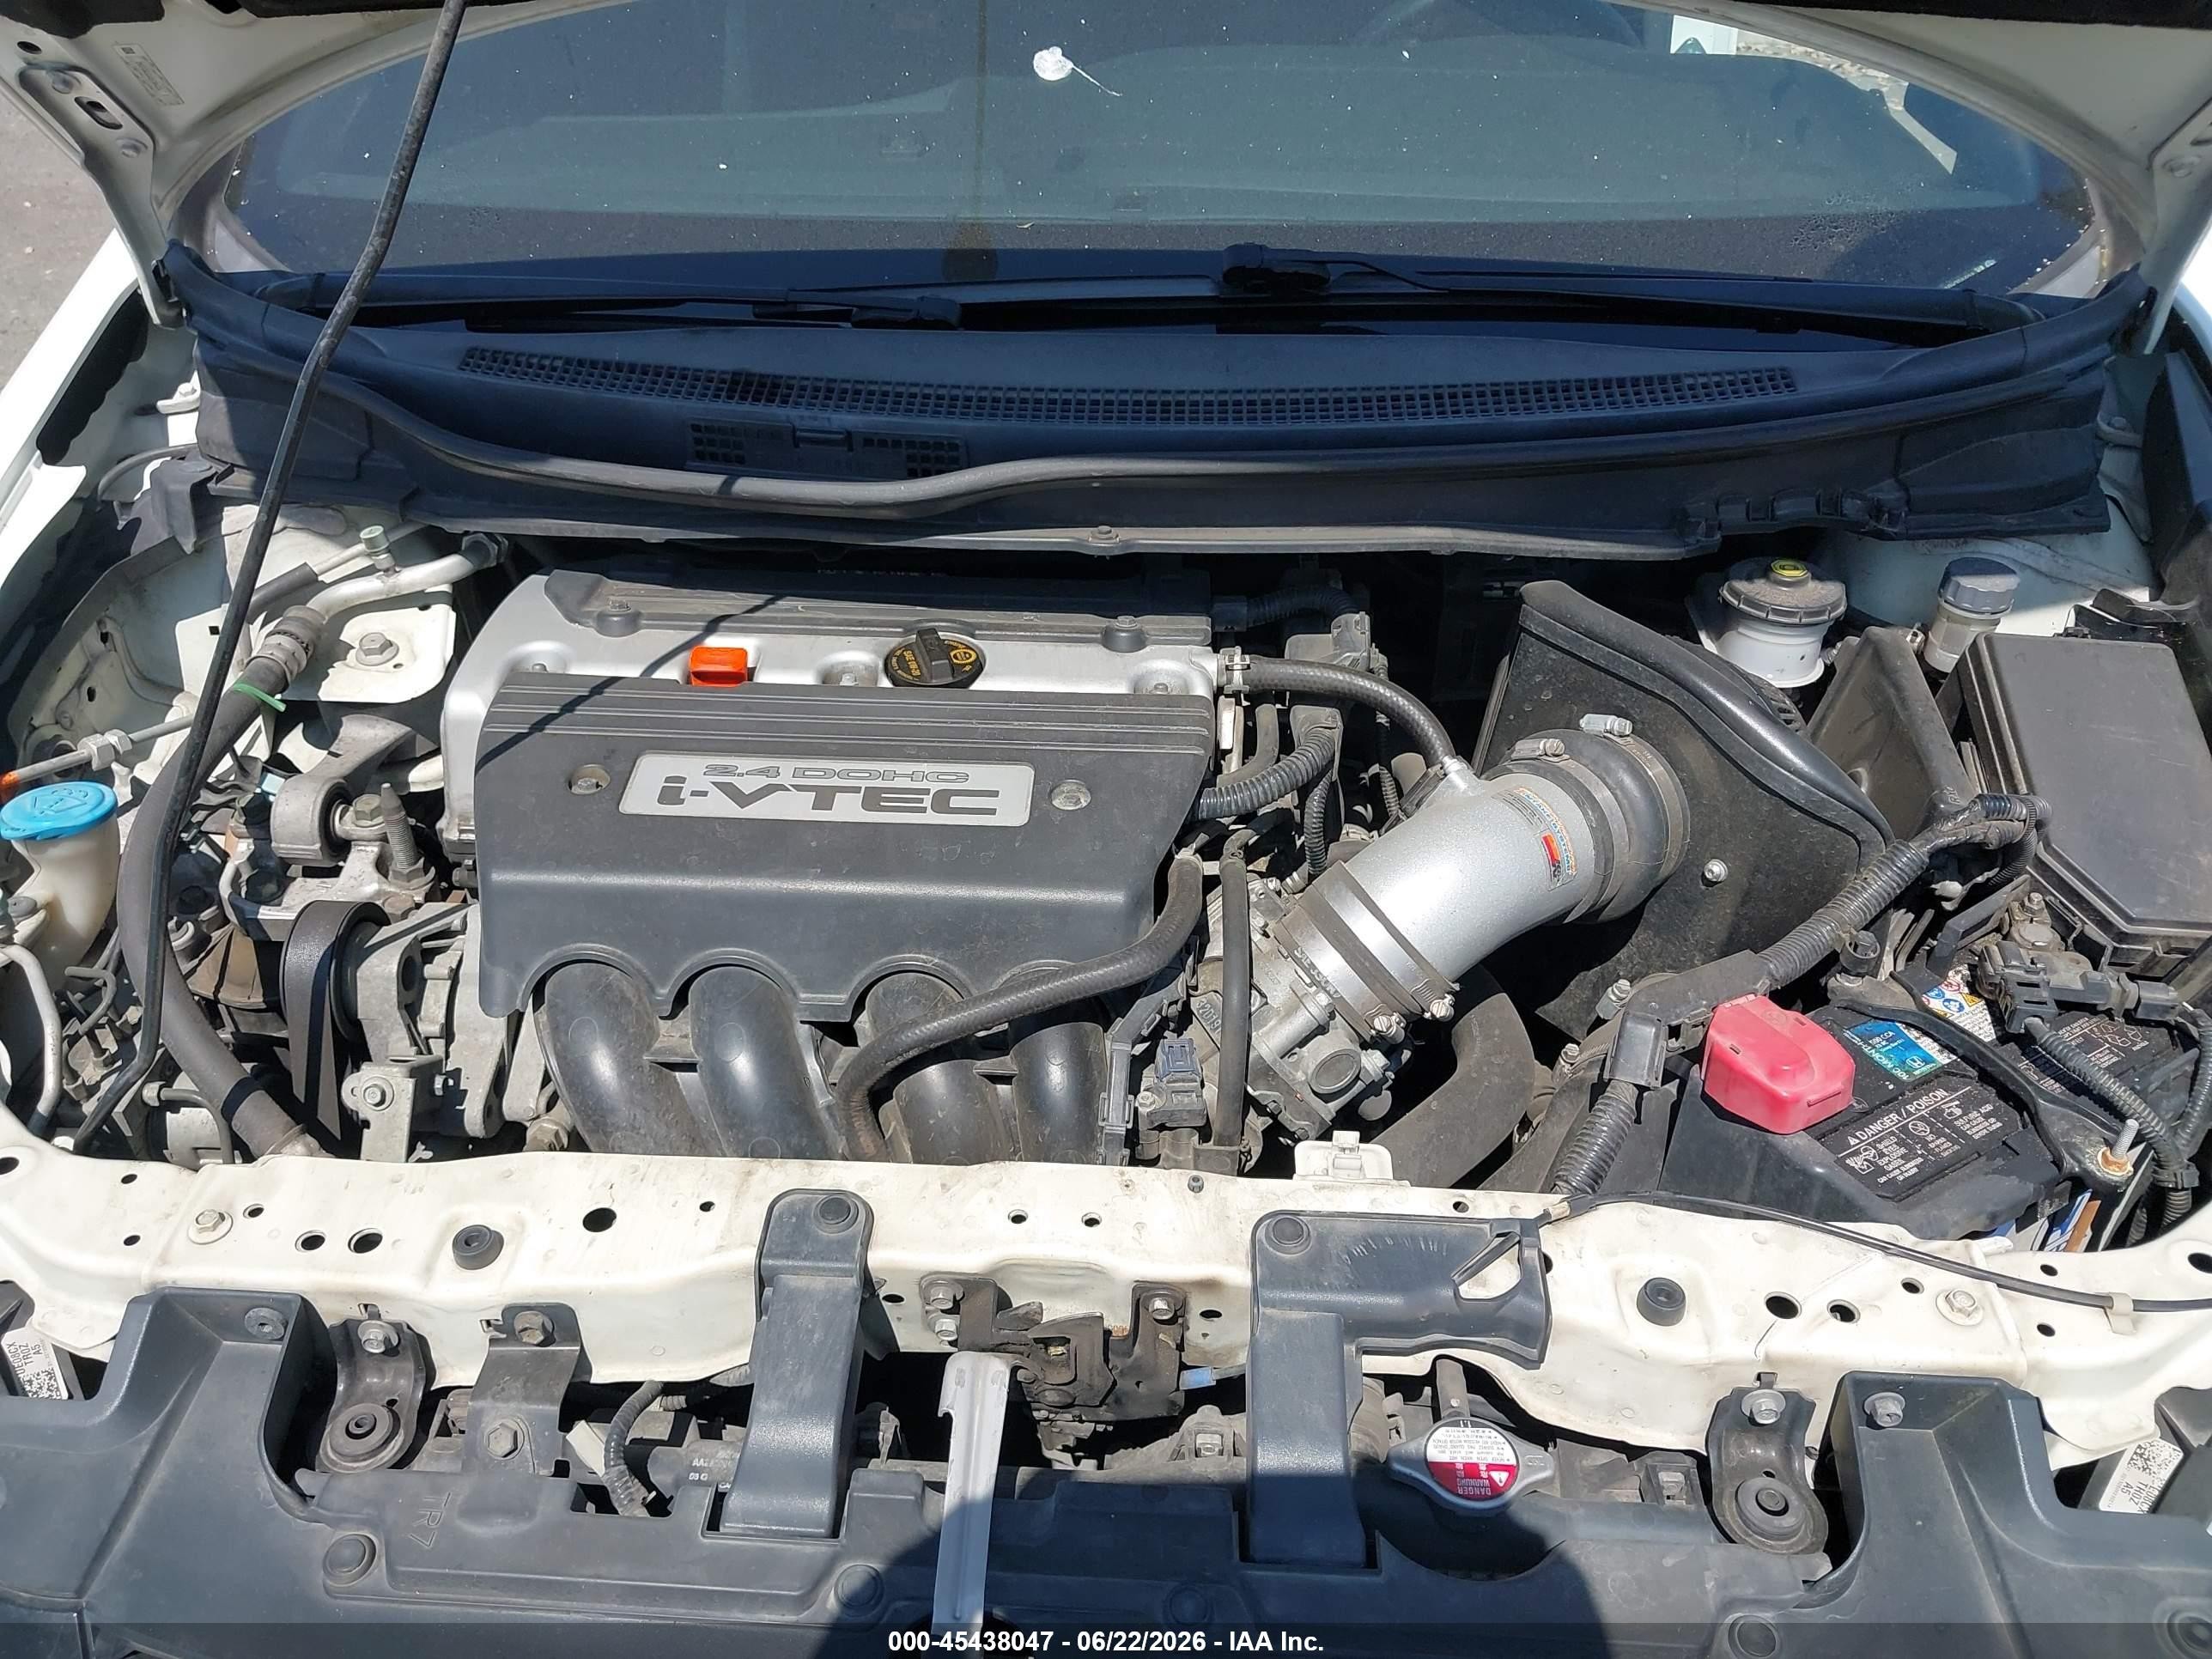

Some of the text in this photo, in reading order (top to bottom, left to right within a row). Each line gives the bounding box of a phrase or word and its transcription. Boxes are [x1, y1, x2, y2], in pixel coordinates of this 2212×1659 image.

[704, 764, 969, 783] 2.4 DOHC
[658, 775, 1000, 816] i-VTEC
[1855, 1112, 1903, 1140] DANGER
[1905, 1089, 1950, 1114] POISON
[1876, 1136, 1898, 1151] SHIELD
[32, 1344, 42, 1355] A5
[1457, 1486, 1492, 1496] DANGER
[2120, 1481, 2135, 1496] A5
